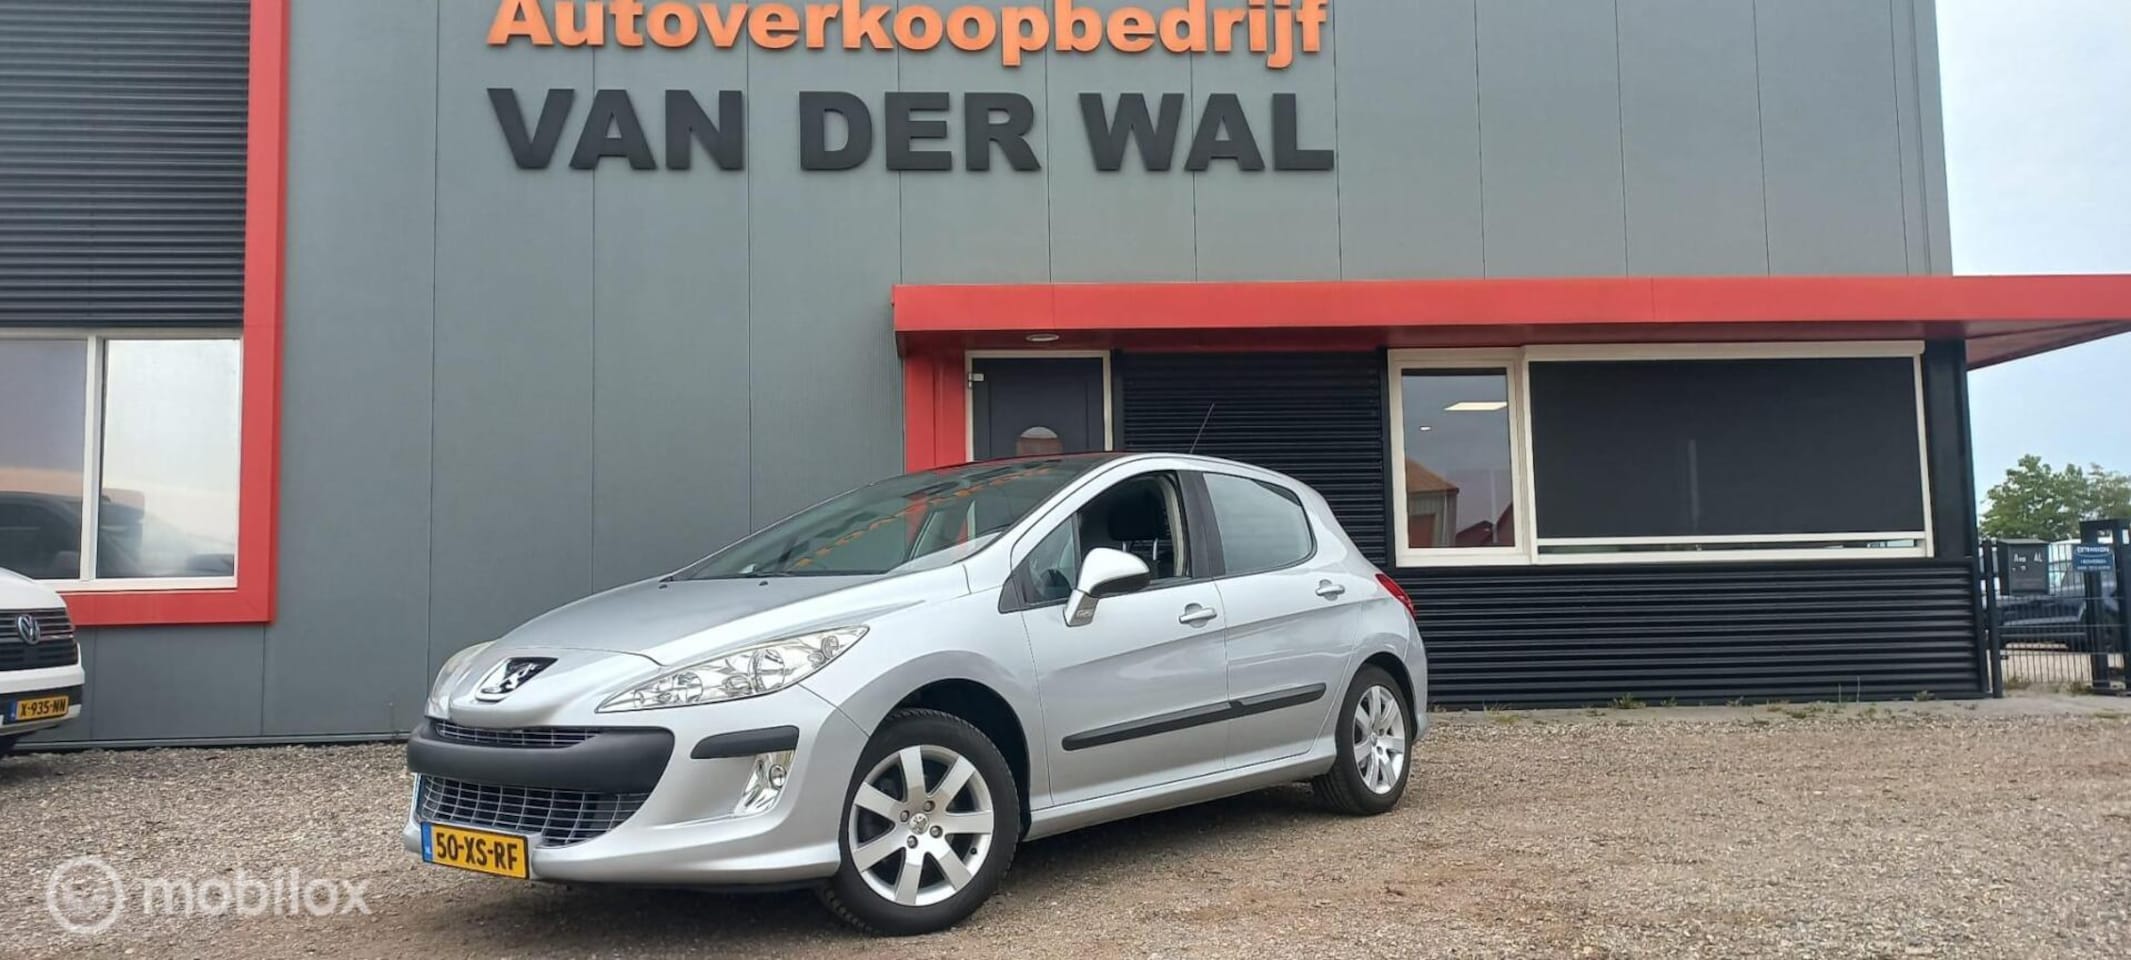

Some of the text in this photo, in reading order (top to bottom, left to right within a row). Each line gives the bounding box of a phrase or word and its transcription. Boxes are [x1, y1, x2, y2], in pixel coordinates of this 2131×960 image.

[487, 0, 1328, 68] Autoverkoopbedrijf
[487, 88, 1335, 171] VAN DER WAL
[20, 698, 67, 717] X-935-NN
[433, 830, 518, 871] 50-XS-RF
